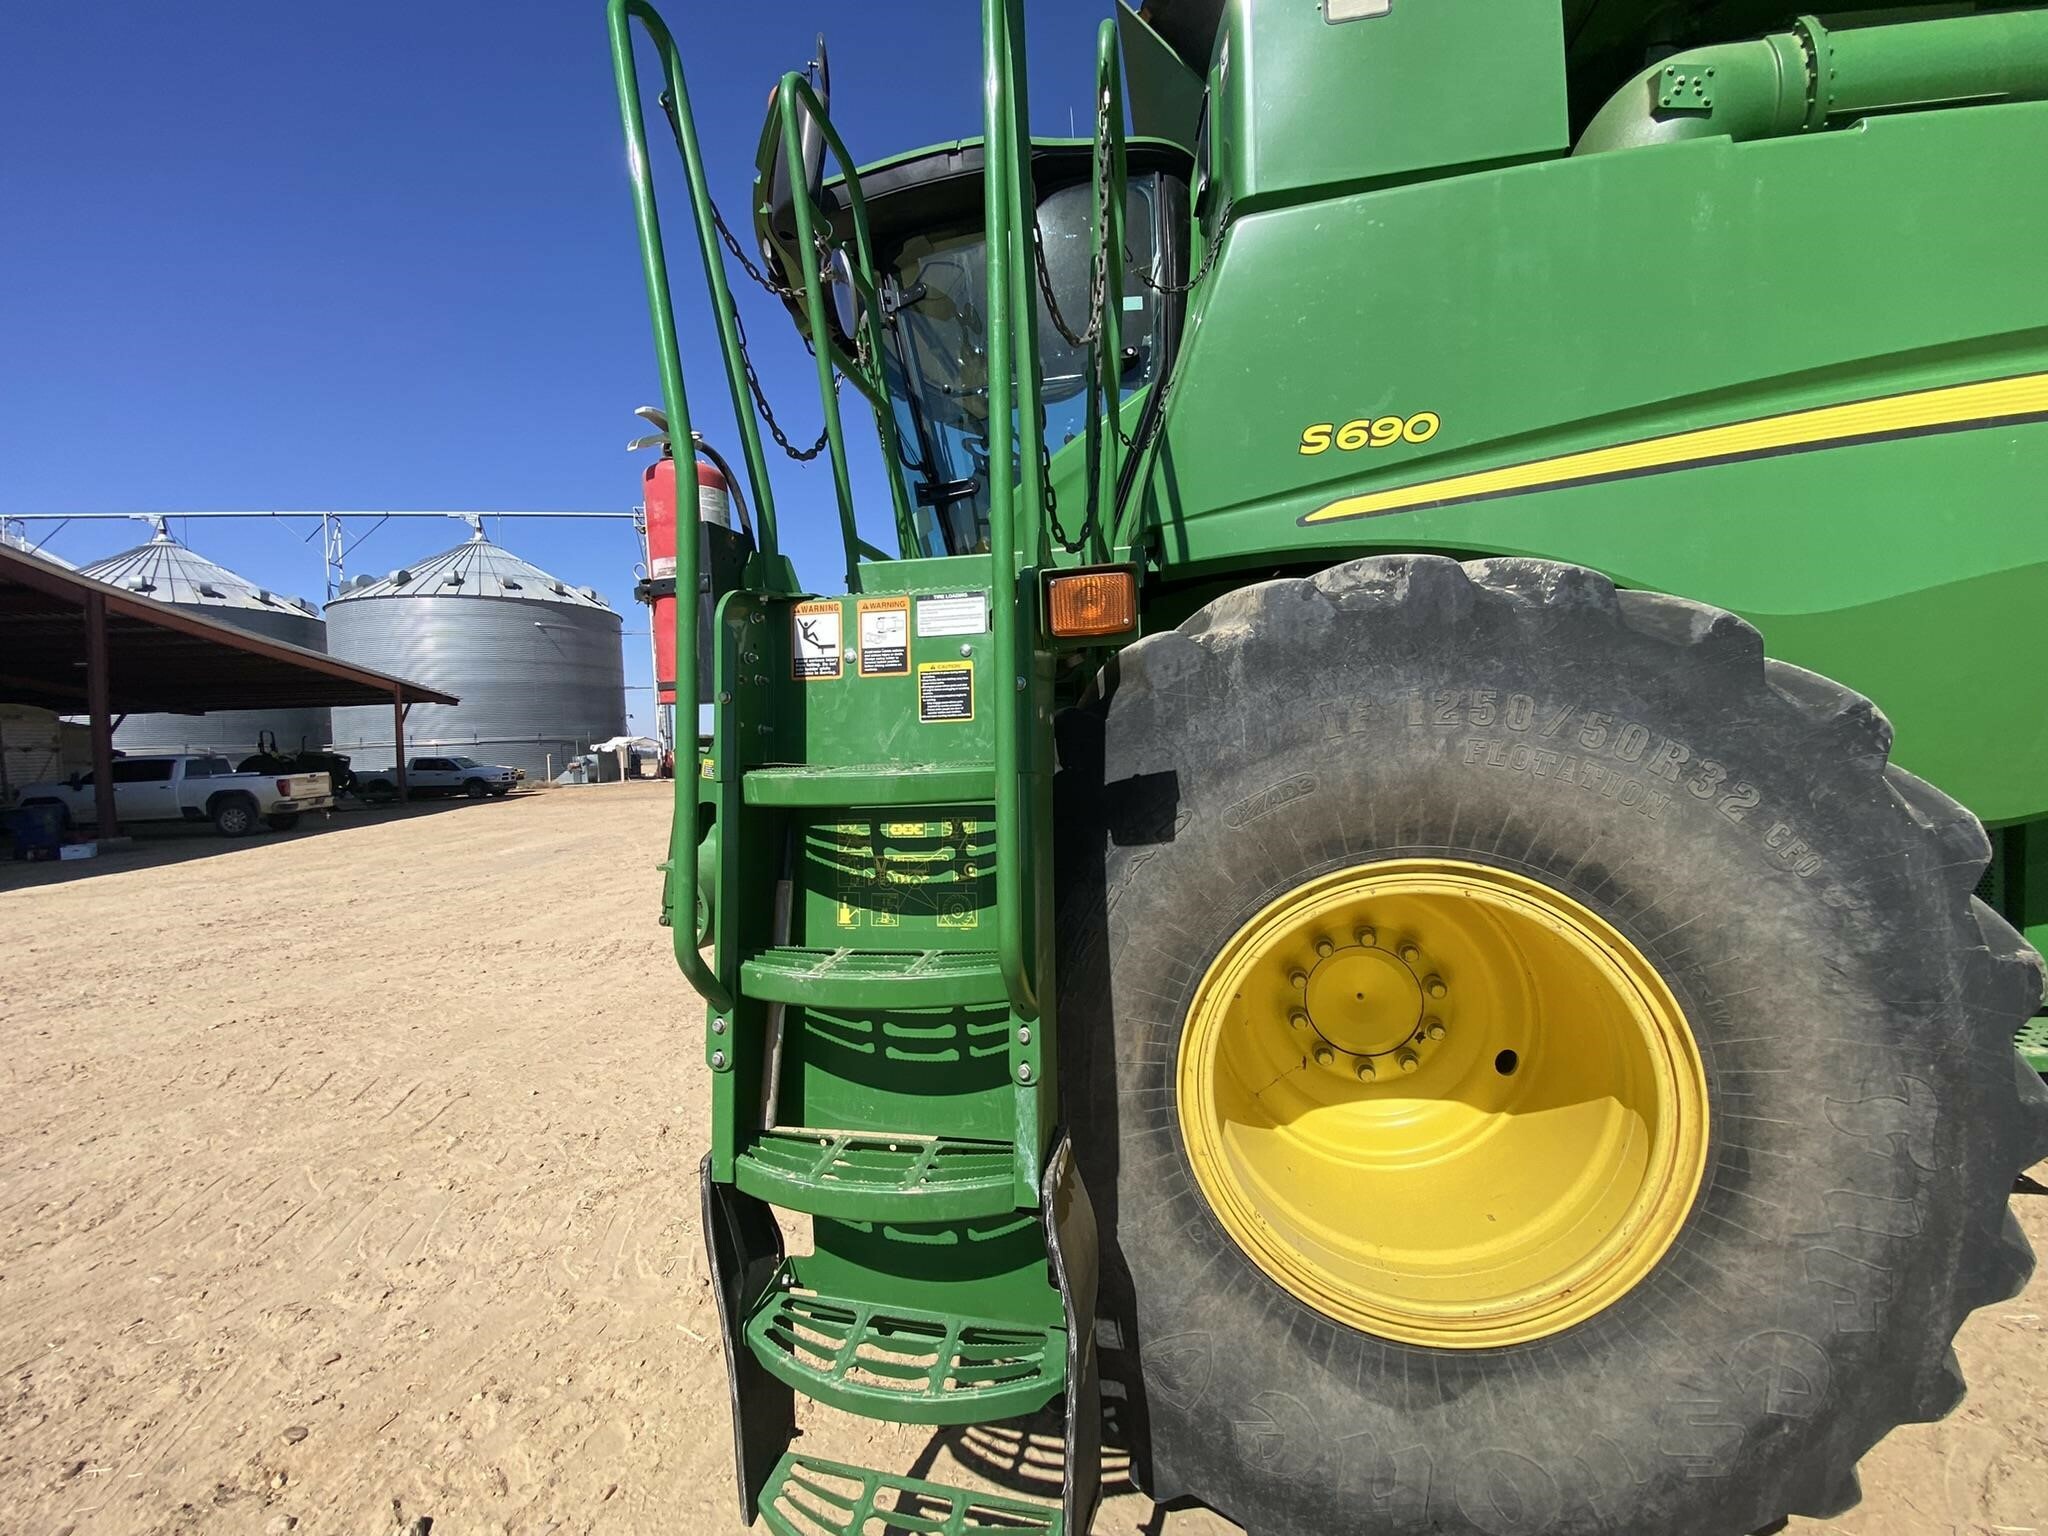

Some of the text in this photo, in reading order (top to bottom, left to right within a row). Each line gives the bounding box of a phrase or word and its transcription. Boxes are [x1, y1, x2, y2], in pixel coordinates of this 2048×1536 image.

[1299, 411, 1440, 455] S690
[801, 604, 839, 613] WARNING
[870, 601, 905, 609] WARNING
[1408, 688, 1761, 825] 1250/50R32
[1464, 737, 1672, 820] FLOTATION
